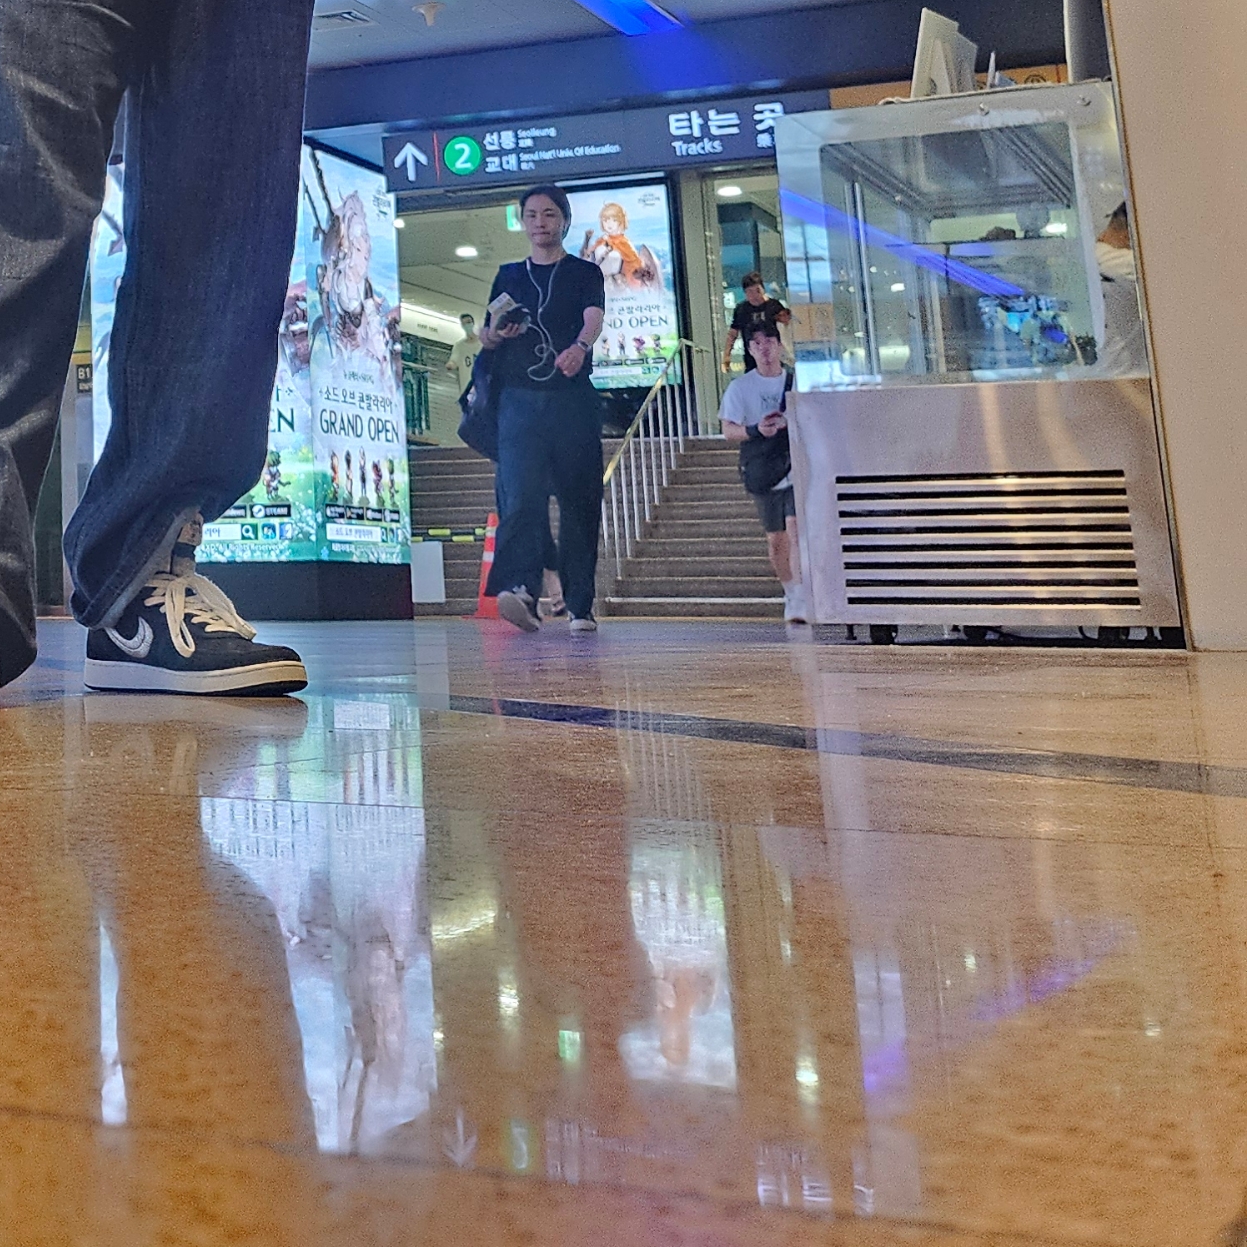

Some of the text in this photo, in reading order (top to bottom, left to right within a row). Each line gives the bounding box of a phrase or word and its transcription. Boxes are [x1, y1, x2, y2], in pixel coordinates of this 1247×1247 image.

[669, 102, 784, 139] 타는 곳
[483, 130, 516, 151] 선릉
[672, 138, 723, 157] Tracks
[454, 143, 472, 169] 2
[485, 153, 518, 172] 교대
[629, 315, 668, 328] OPEN
[324, 386, 393, 414] 소드 오브 콘발라리아
[320, 408, 364, 438] GRAND
[367, 416, 400, 443] OPEN
